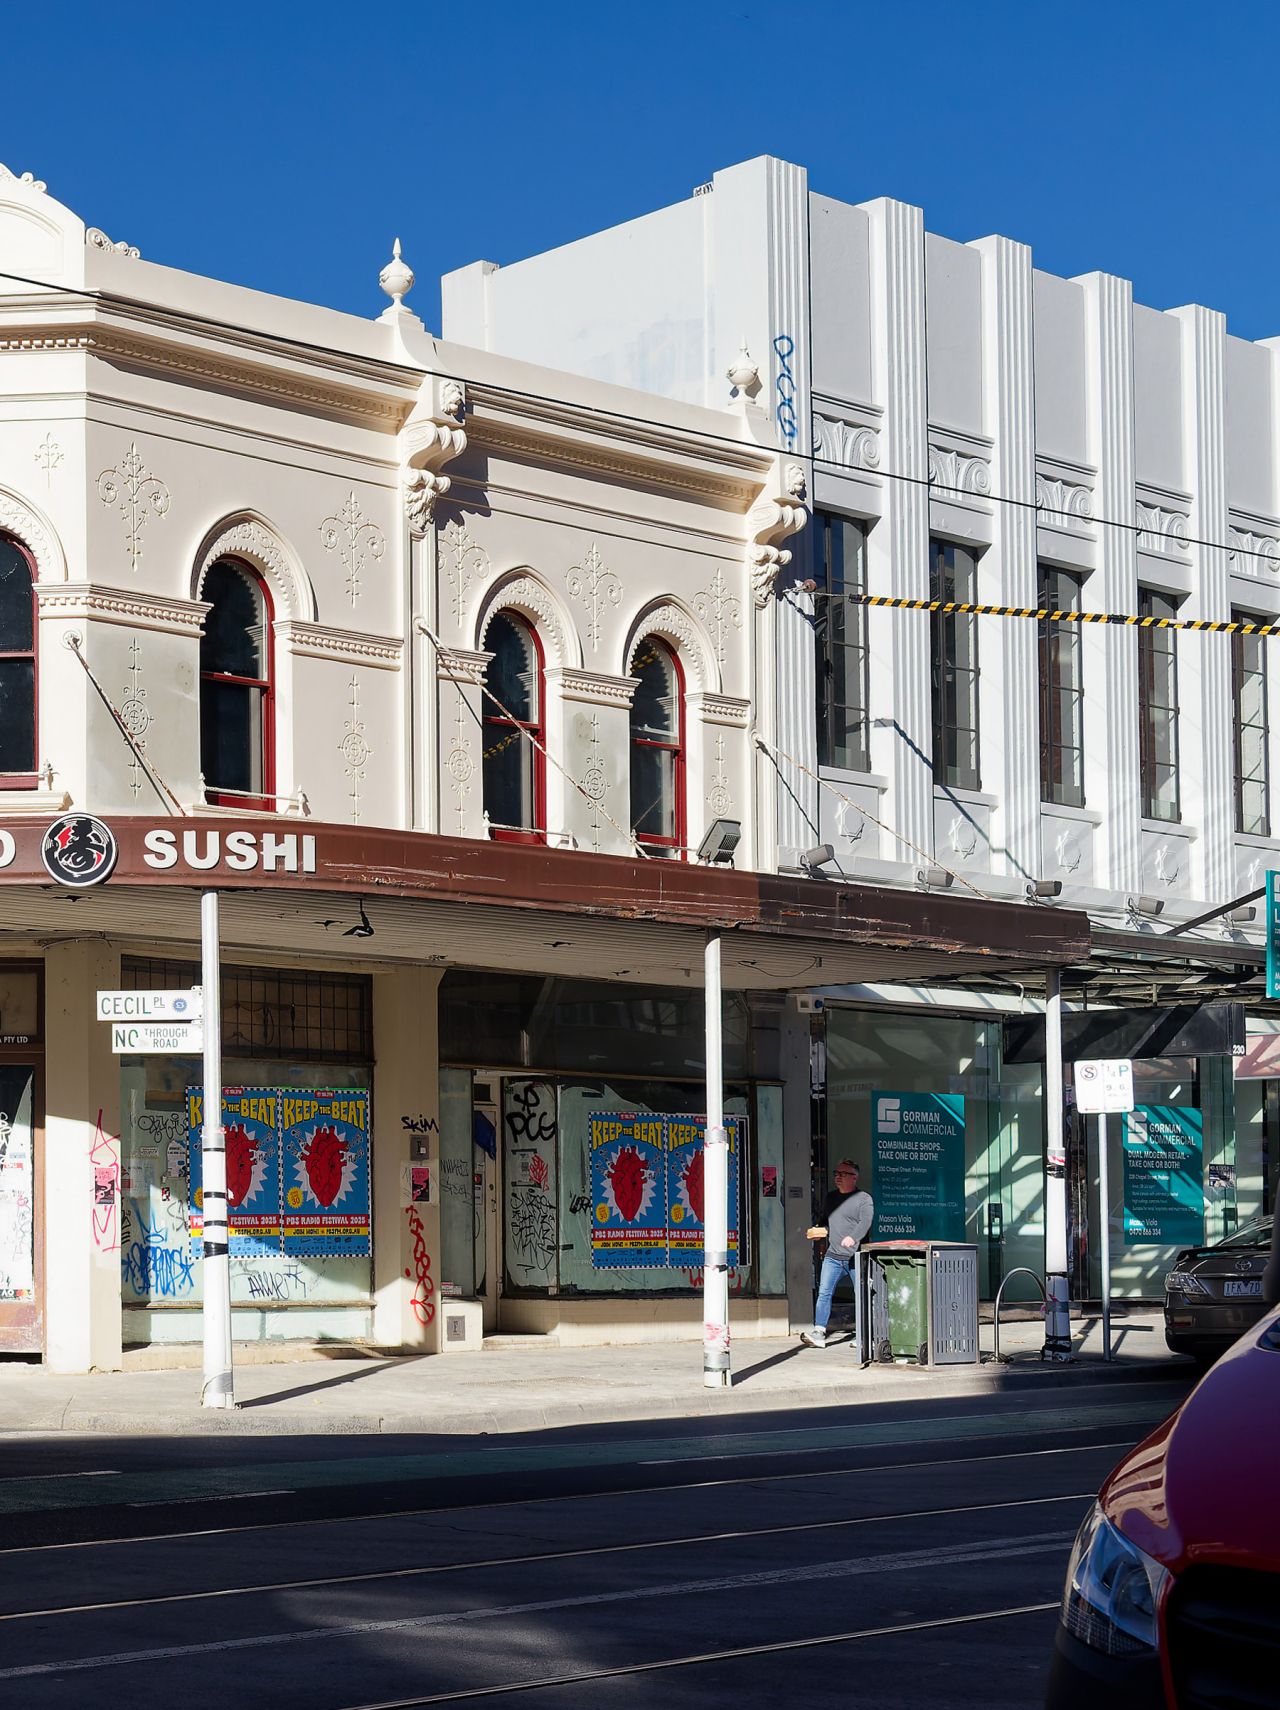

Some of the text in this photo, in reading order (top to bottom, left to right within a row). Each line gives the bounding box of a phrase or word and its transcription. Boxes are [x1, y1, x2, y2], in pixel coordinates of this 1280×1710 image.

[143, 829, 316, 873] SUSHI
[101, 996, 166, 1015] CECIL PL
[144, 1028, 188, 1038] THROUGH
[3, 1036, 15, 1044] PTY
[16, 1036, 29, 1044] LTD
[115, 1029, 139, 1048] NO
[153, 1038, 179, 1048] ROAD
[1232, 1044, 1245, 1055] 230
[227, 1103, 240, 1112] THE
[240, 1098, 277, 1130] BEAT
[283, 1098, 319, 1131] KEEP
[331, 1100, 366, 1131] BEAT
[902, 1110, 940, 1122] GORMAN
[902, 1123, 957, 1136] COMMERCIAL
[1149, 1123, 1182, 1134] GORMAN
[592, 1120, 623, 1150] KEEP
[633, 1122, 663, 1150] BEAT
[669, 1122, 698, 1152] KEEP
[877, 1140, 919, 1150] COMBINABLE
[1149, 1135, 1196, 1146] COMMERCIAL
[878, 1150, 939, 1161] TAKE ONE OR BOTH!
[1127, 1150, 1143, 1159] DUAL
[1144, 1151, 1167, 1159] MODERN
[1168, 1151, 1186, 1160] RETAIL
[1128, 1160, 1142, 1168] TAKE
[1155, 1161, 1164, 1169] OR
[230, 1216, 277, 1226] FESTIVAL 2025
[286, 1216, 366, 1225] PBS RADIO FESTIVAL 2025
[878, 1214, 898, 1223] Mason
[594, 1229, 664, 1239] PBS RADIO FESTIVAL 2025
[878, 1225, 894, 1233] 0470
[1128, 1228, 1142, 1236] 0470
[681, 1231, 698, 1239] RADIO
